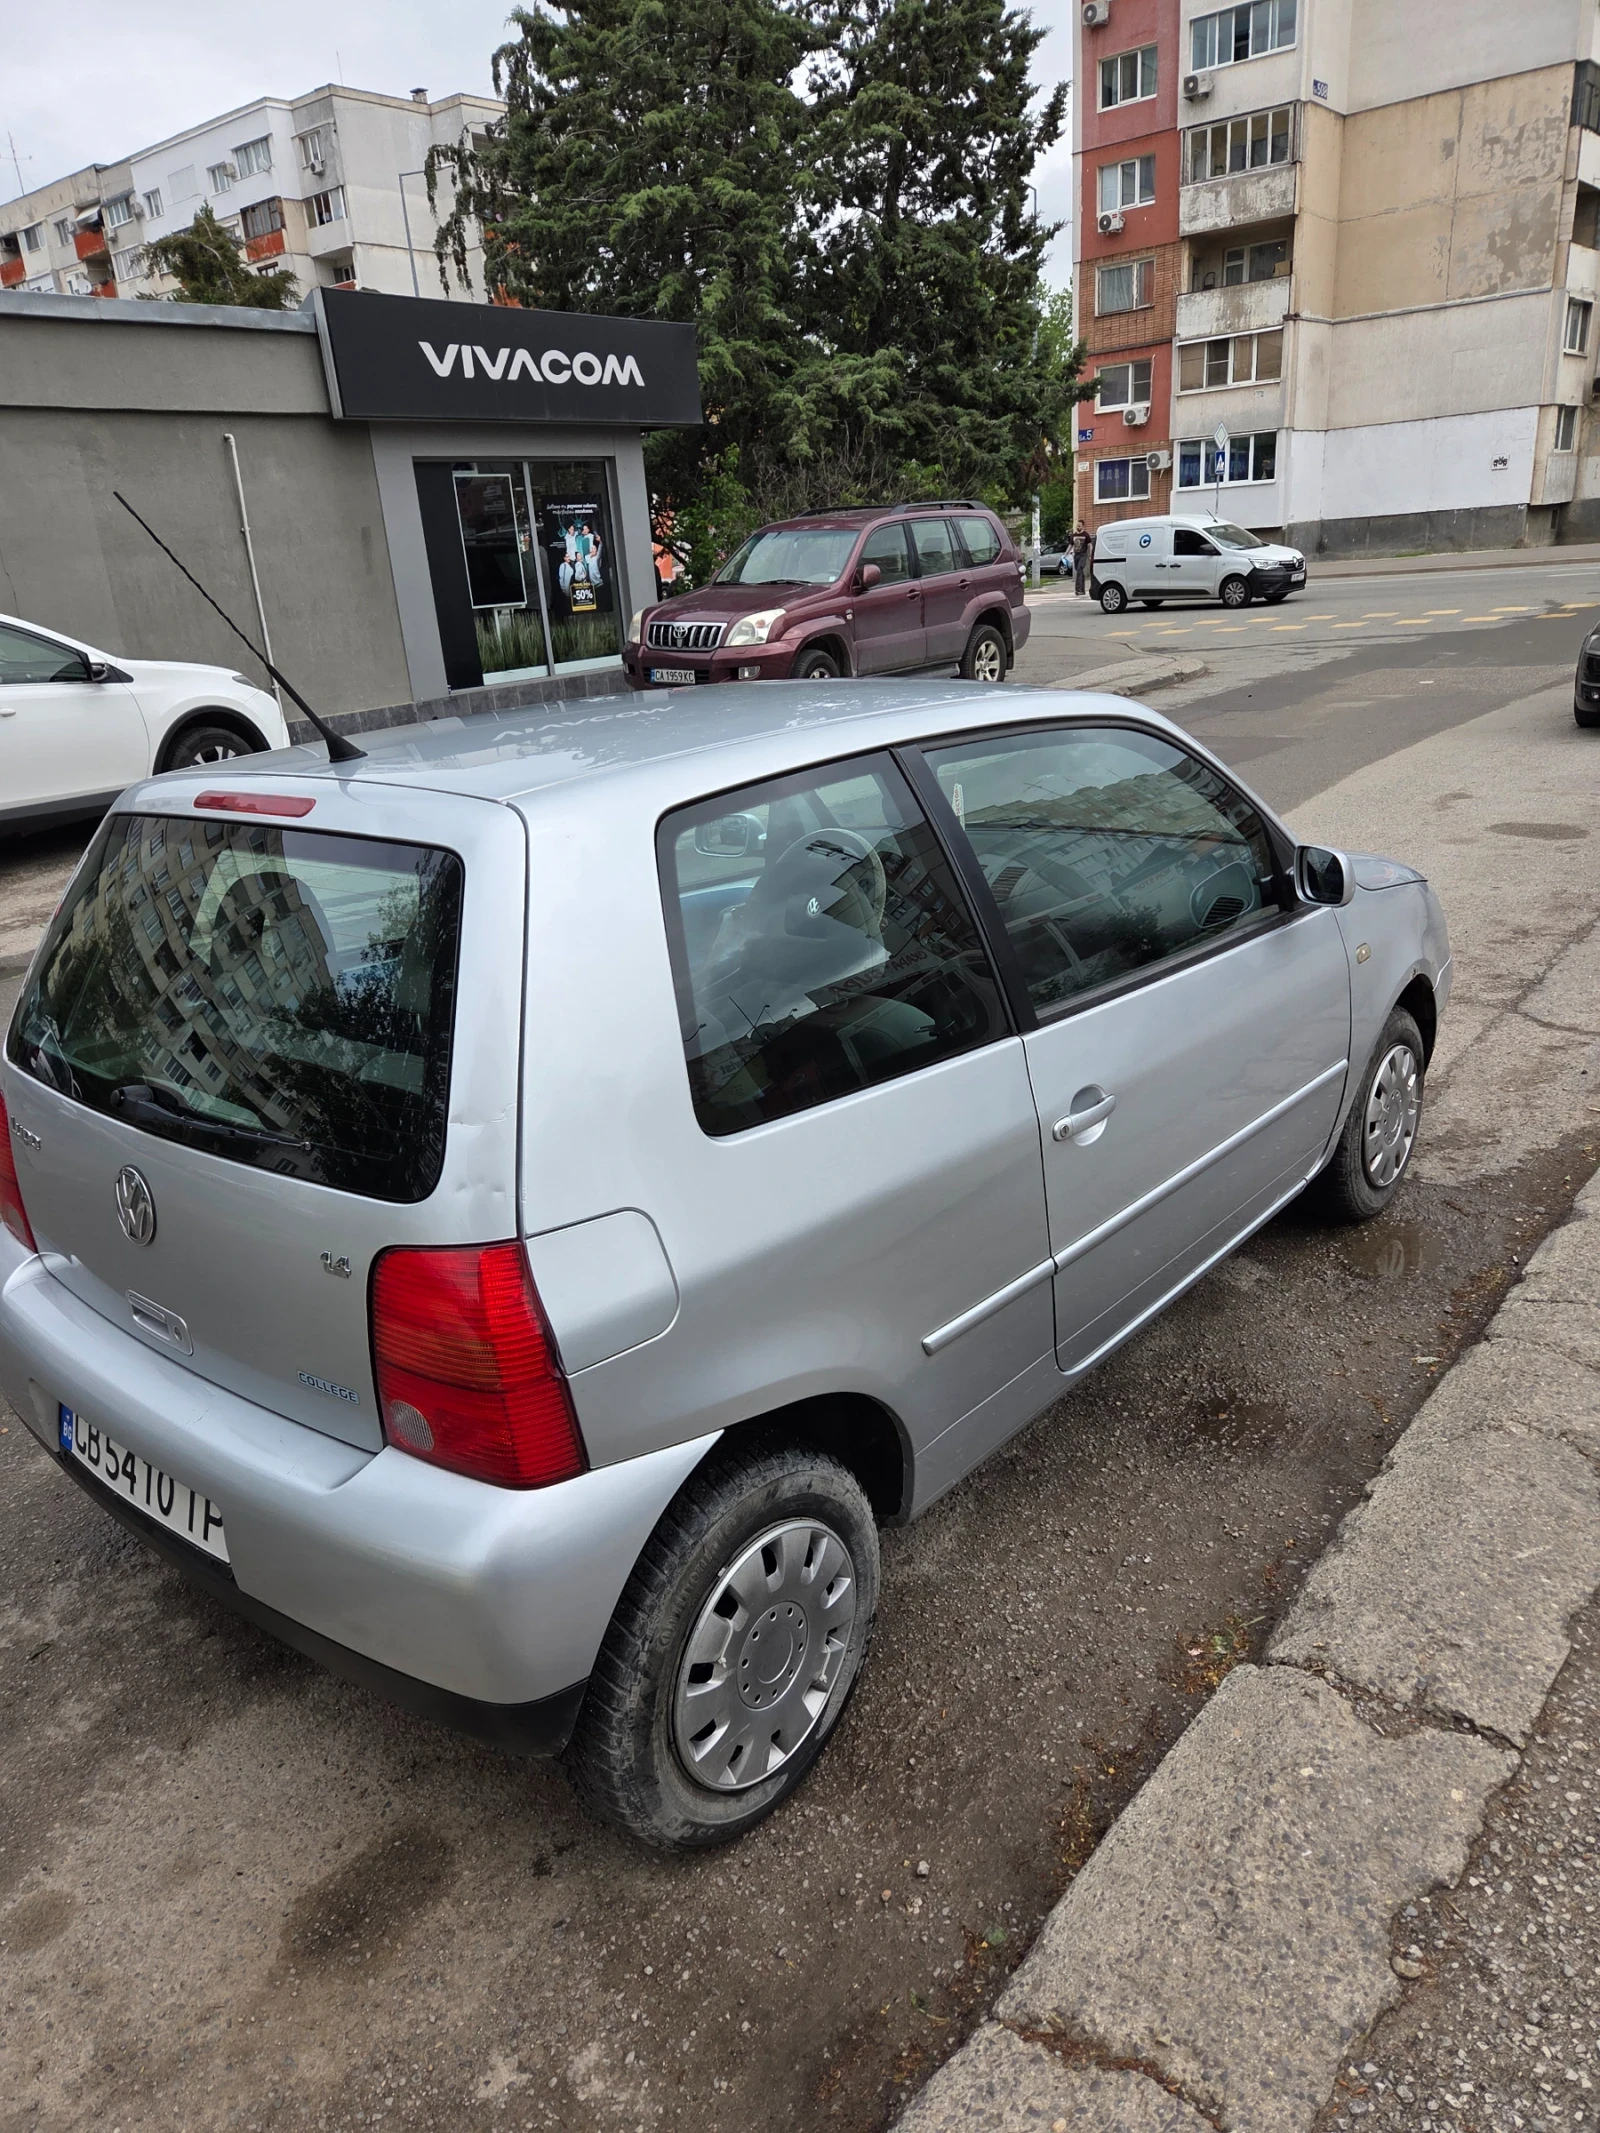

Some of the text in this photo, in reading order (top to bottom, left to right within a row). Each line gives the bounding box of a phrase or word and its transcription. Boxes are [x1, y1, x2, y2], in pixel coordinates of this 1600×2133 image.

[418, 341, 645, 386] VIVACOM
[573, 589, 593, 600] -50%
[655, 671, 694, 682] CA 1959 KC
[298, 1372, 358, 1403] COLLEGE
[62, 1421, 72, 1441] BG
[105, 1436, 175, 1517] 5410
